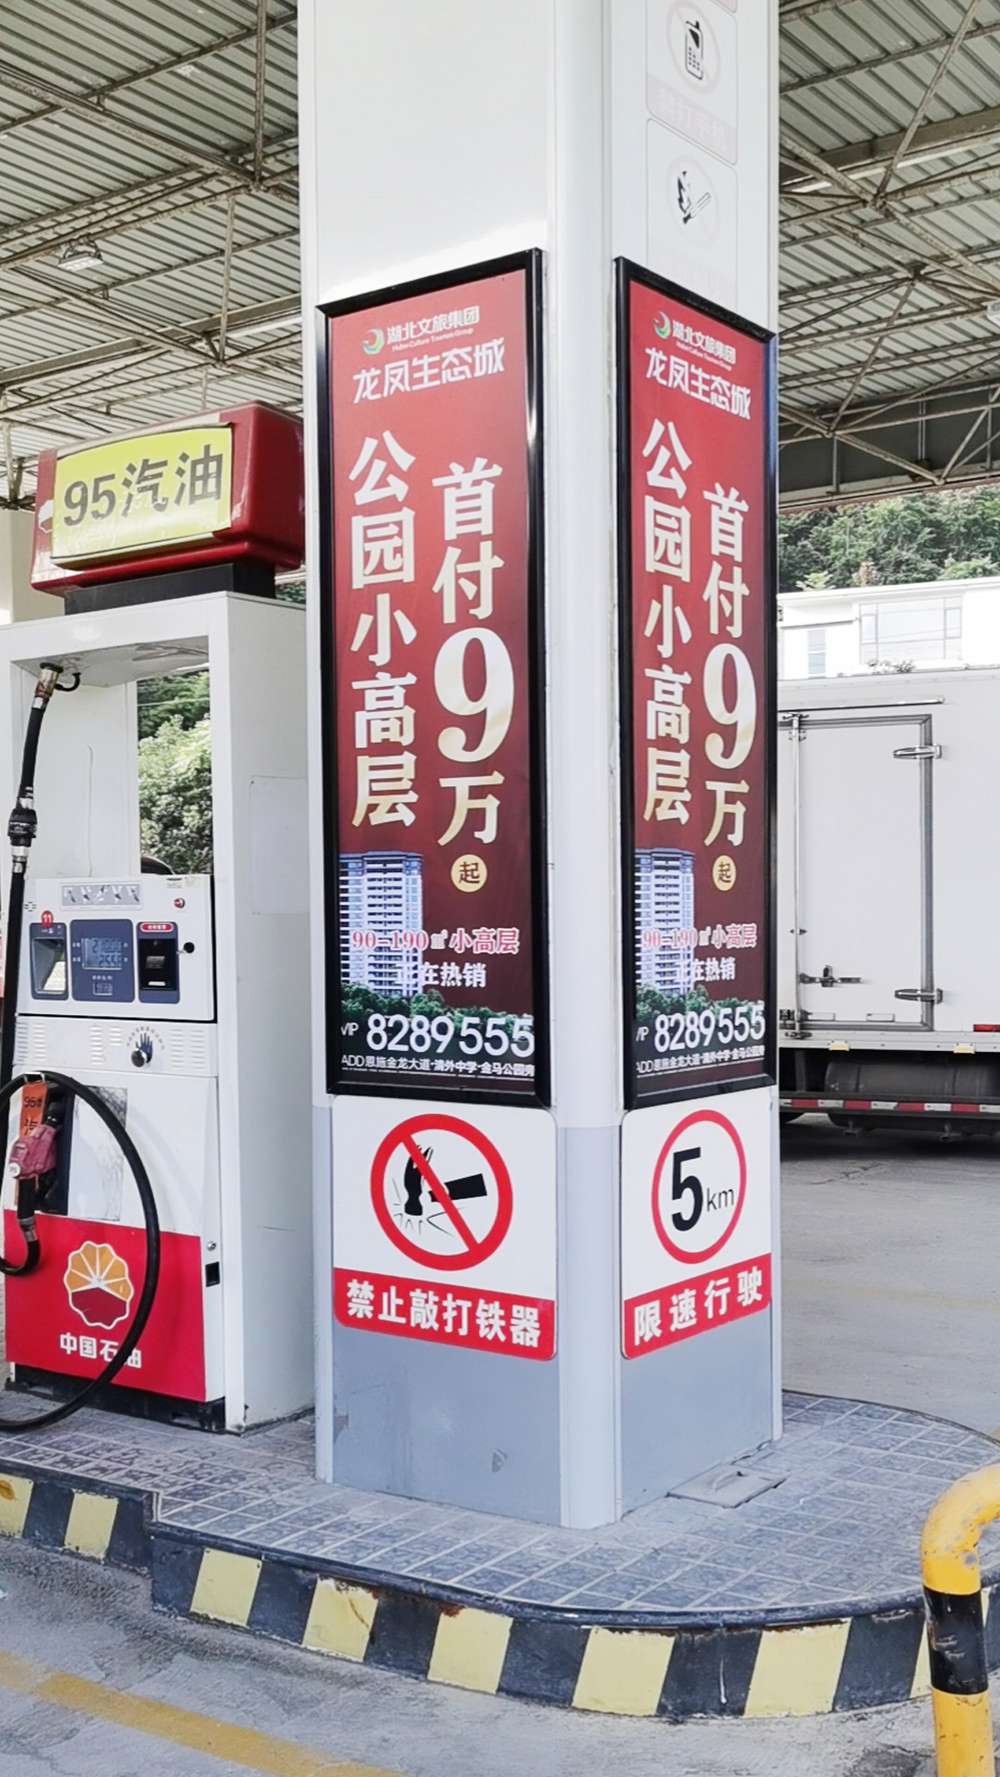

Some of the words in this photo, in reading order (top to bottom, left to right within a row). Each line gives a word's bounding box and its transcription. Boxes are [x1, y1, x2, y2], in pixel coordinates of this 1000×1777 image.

[387, 305, 481, 345] 湖北文旅集团
[672, 320, 737, 365] 湖北文旅集团
[353, 337, 505, 404] 龙凤生态城
[645, 346, 751, 421] 龙凤生态城
[63, 444, 223, 527] 95汽油
[349, 430, 418, 827] 公园小高层
[642, 418, 693, 825] 公园小高层
[366, 1013, 535, 1058] 8289555
[654, 1005, 766, 1053] 8289555
[671, 1147, 704, 1232] 5
[706, 1187, 735, 1212] km
[347, 1279, 541, 1347] 禁止敲打铁器
[633, 1266, 763, 1346] 限速行驶
